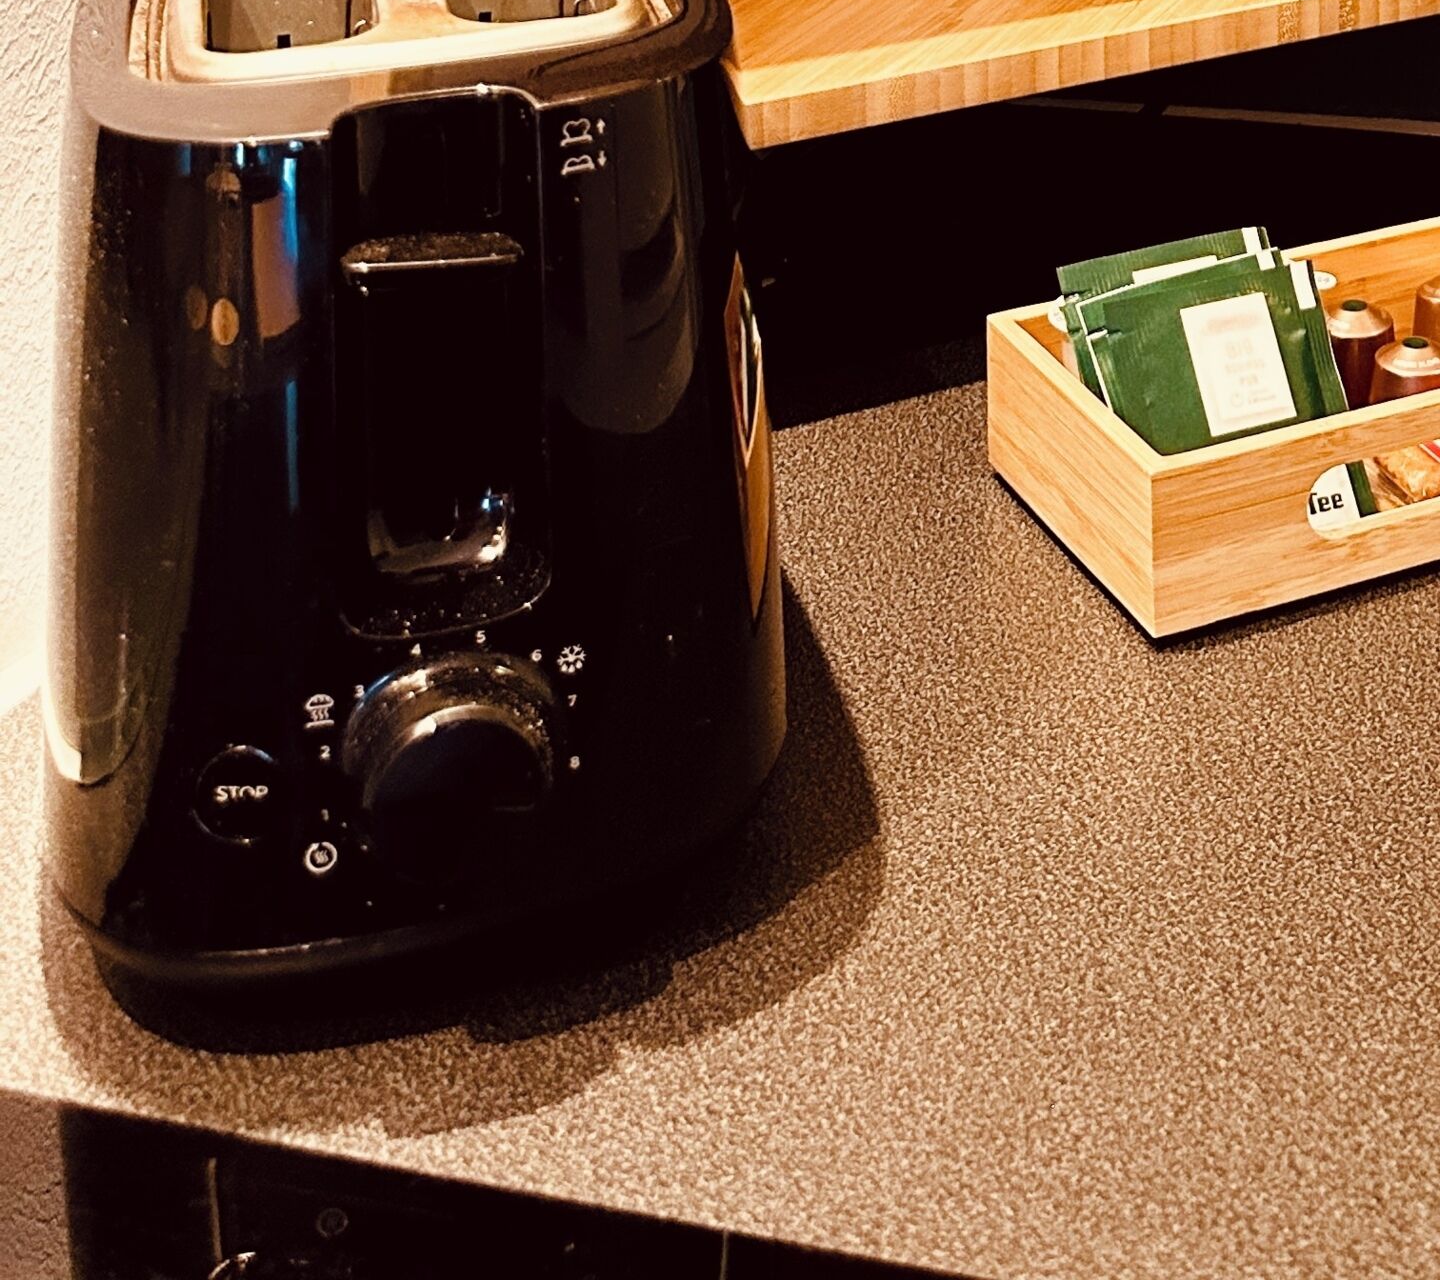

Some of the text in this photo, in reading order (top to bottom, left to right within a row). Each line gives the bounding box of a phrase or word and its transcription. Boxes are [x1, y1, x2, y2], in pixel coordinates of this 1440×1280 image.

[476, 630, 486, 643] 5
[410, 642, 421, 655] 4
[531, 648, 542, 661] 6
[354, 684, 365, 698] 3
[568, 694, 578, 707] 7
[319, 745, 331, 760] 2
[569, 756, 580, 769] 8
[215, 785, 269, 802] STOP
